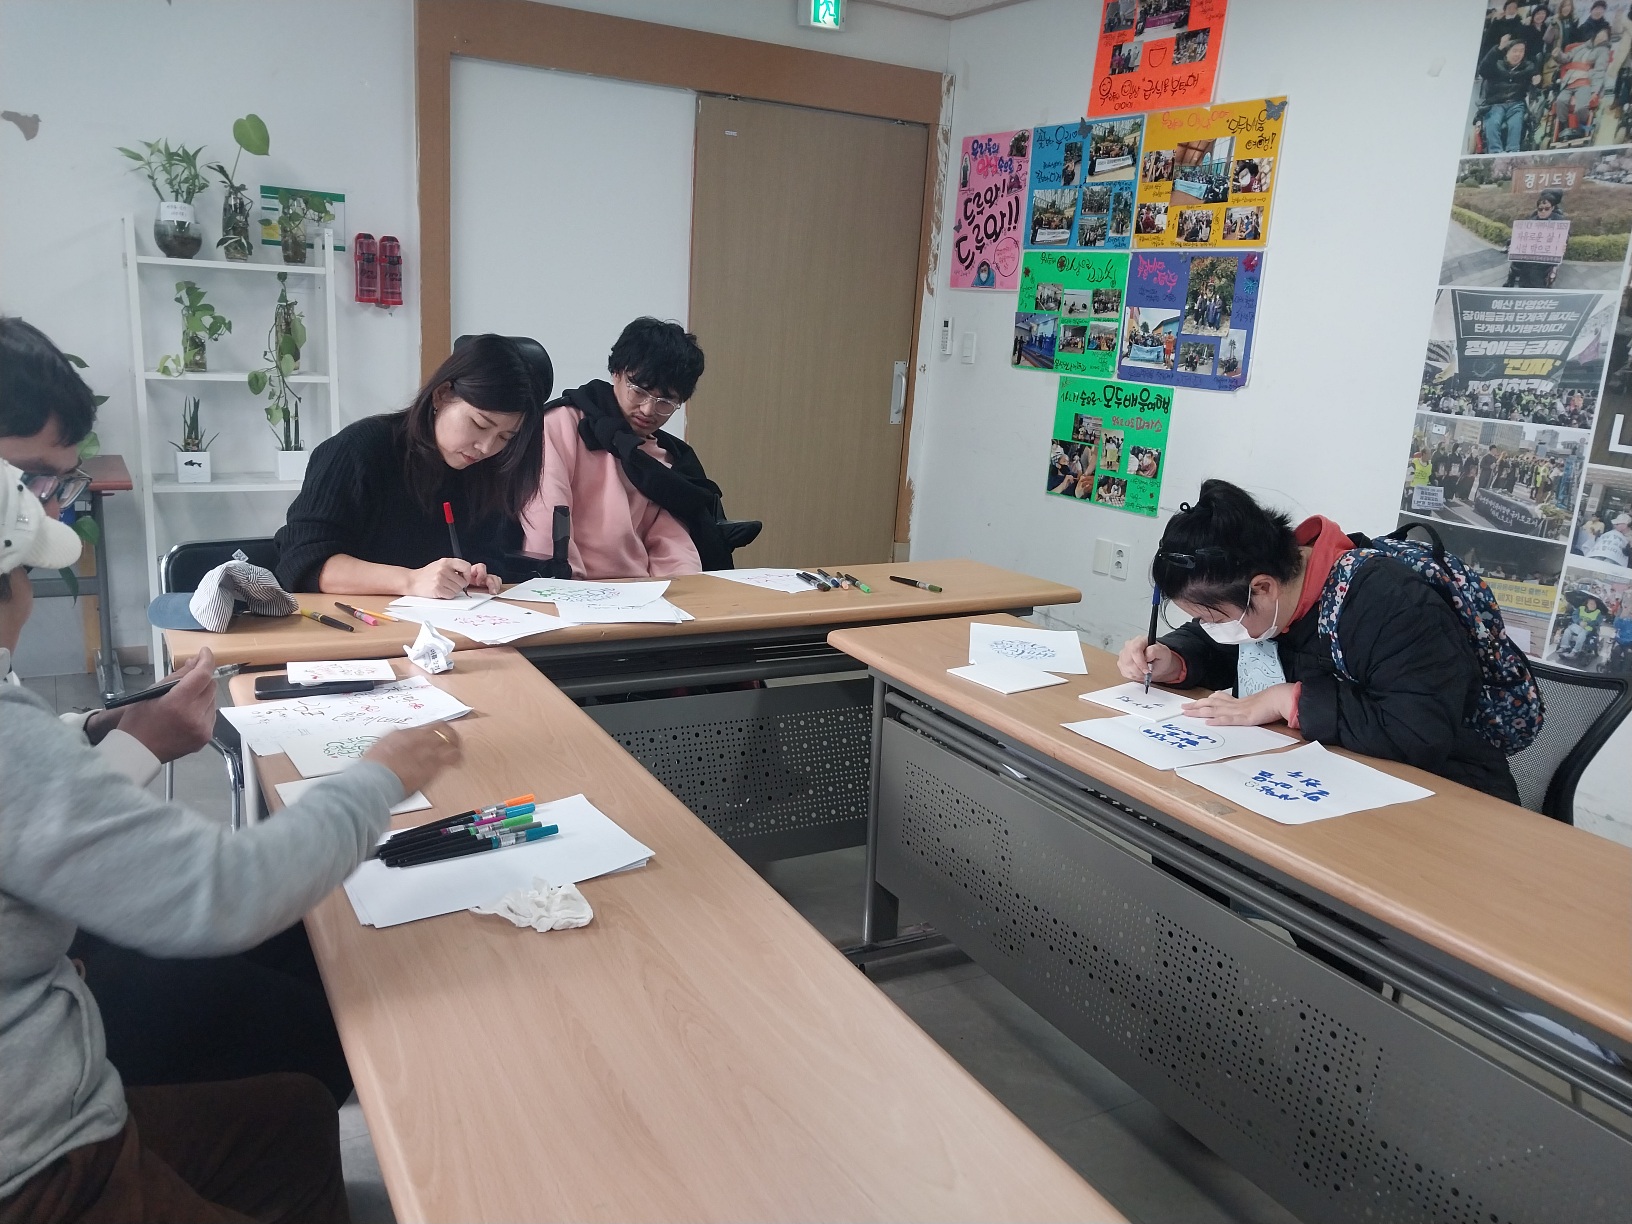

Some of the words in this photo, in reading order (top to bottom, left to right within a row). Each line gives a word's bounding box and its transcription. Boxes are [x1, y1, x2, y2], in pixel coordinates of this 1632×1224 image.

[970, 138, 1000, 157] 우리들의
[1524, 170, 1577, 189] 경기도청
[963, 179, 1007, 226] 드루와!
[955, 195, 1020, 270] 드루와!!
[1517, 231, 1544, 243] 자유로운
[1491, 299, 1513, 310] 예산
[1514, 299, 1560, 310] 반영없는
[1462, 310, 1516, 322] 장애등급제
[1515, 311, 1547, 322] 단계적
[1547, 311, 1581, 321] 폐지는
[1474, 323, 1504, 333] 단계적
[1505, 323, 1567, 333] 사기행각이다!
[1464, 340, 1569, 356] 장애등급제
